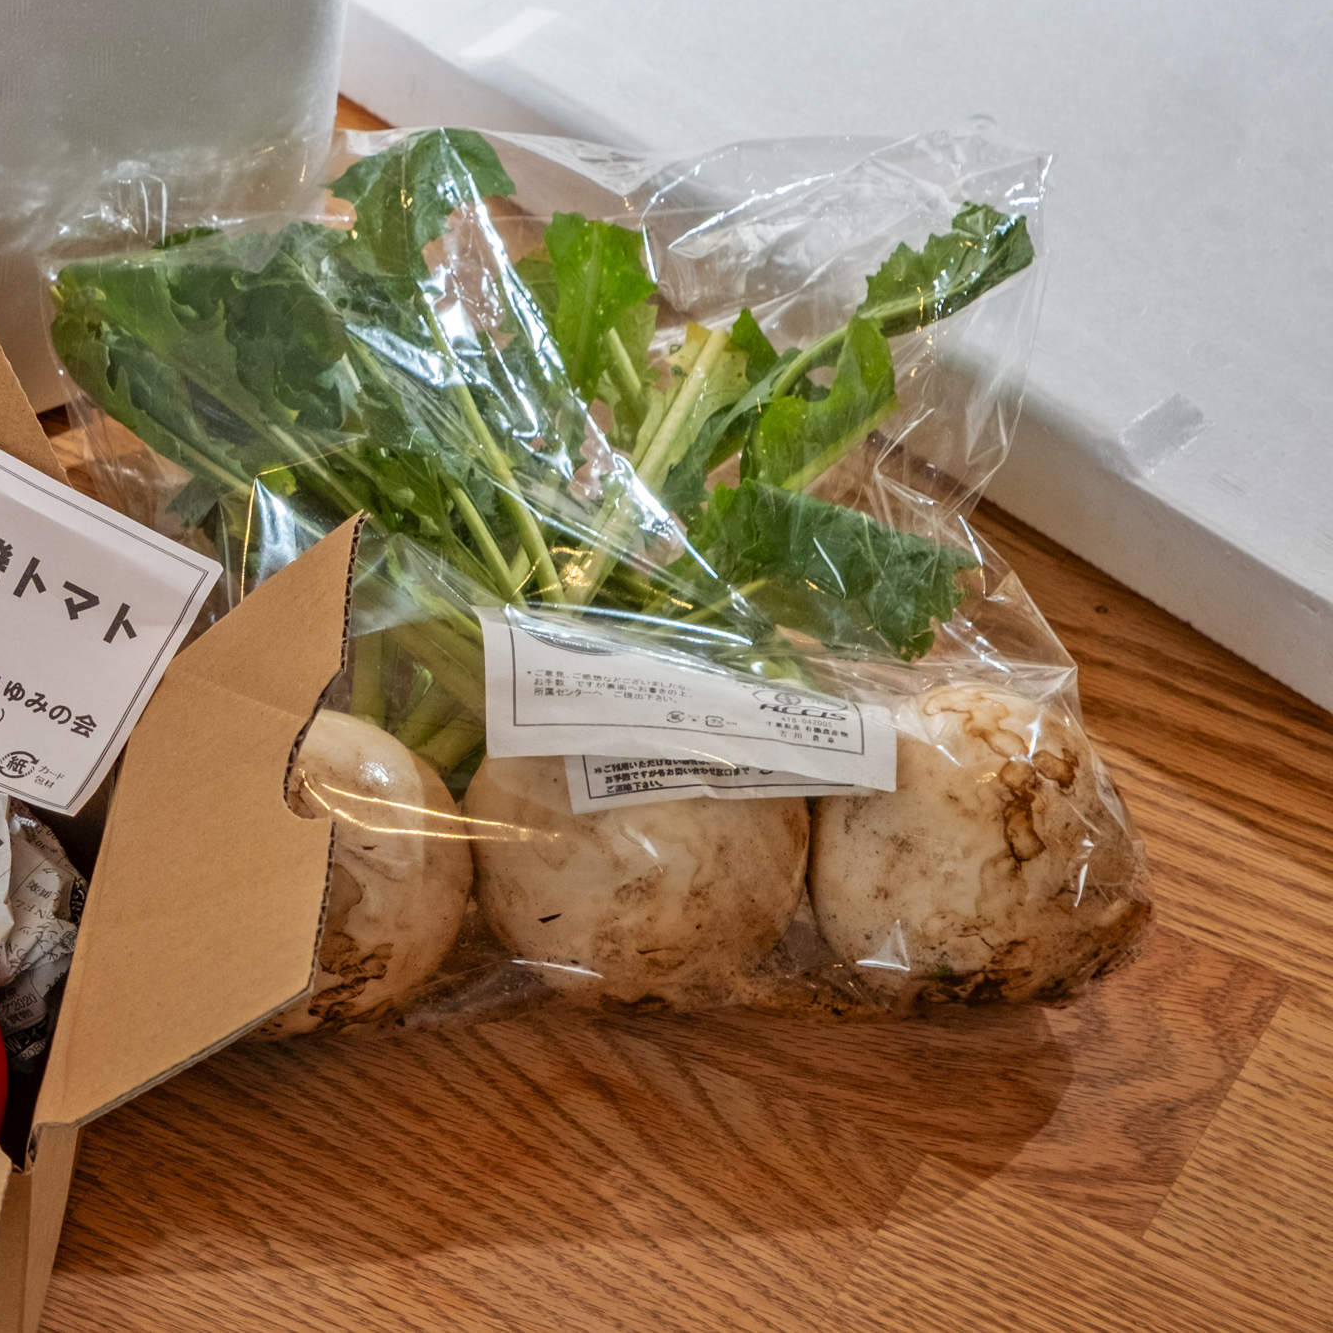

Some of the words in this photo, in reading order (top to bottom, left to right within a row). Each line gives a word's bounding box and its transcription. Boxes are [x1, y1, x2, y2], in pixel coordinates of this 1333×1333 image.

[6, 755, 29, 775] 紙
[38, 765, 65, 780] カード
